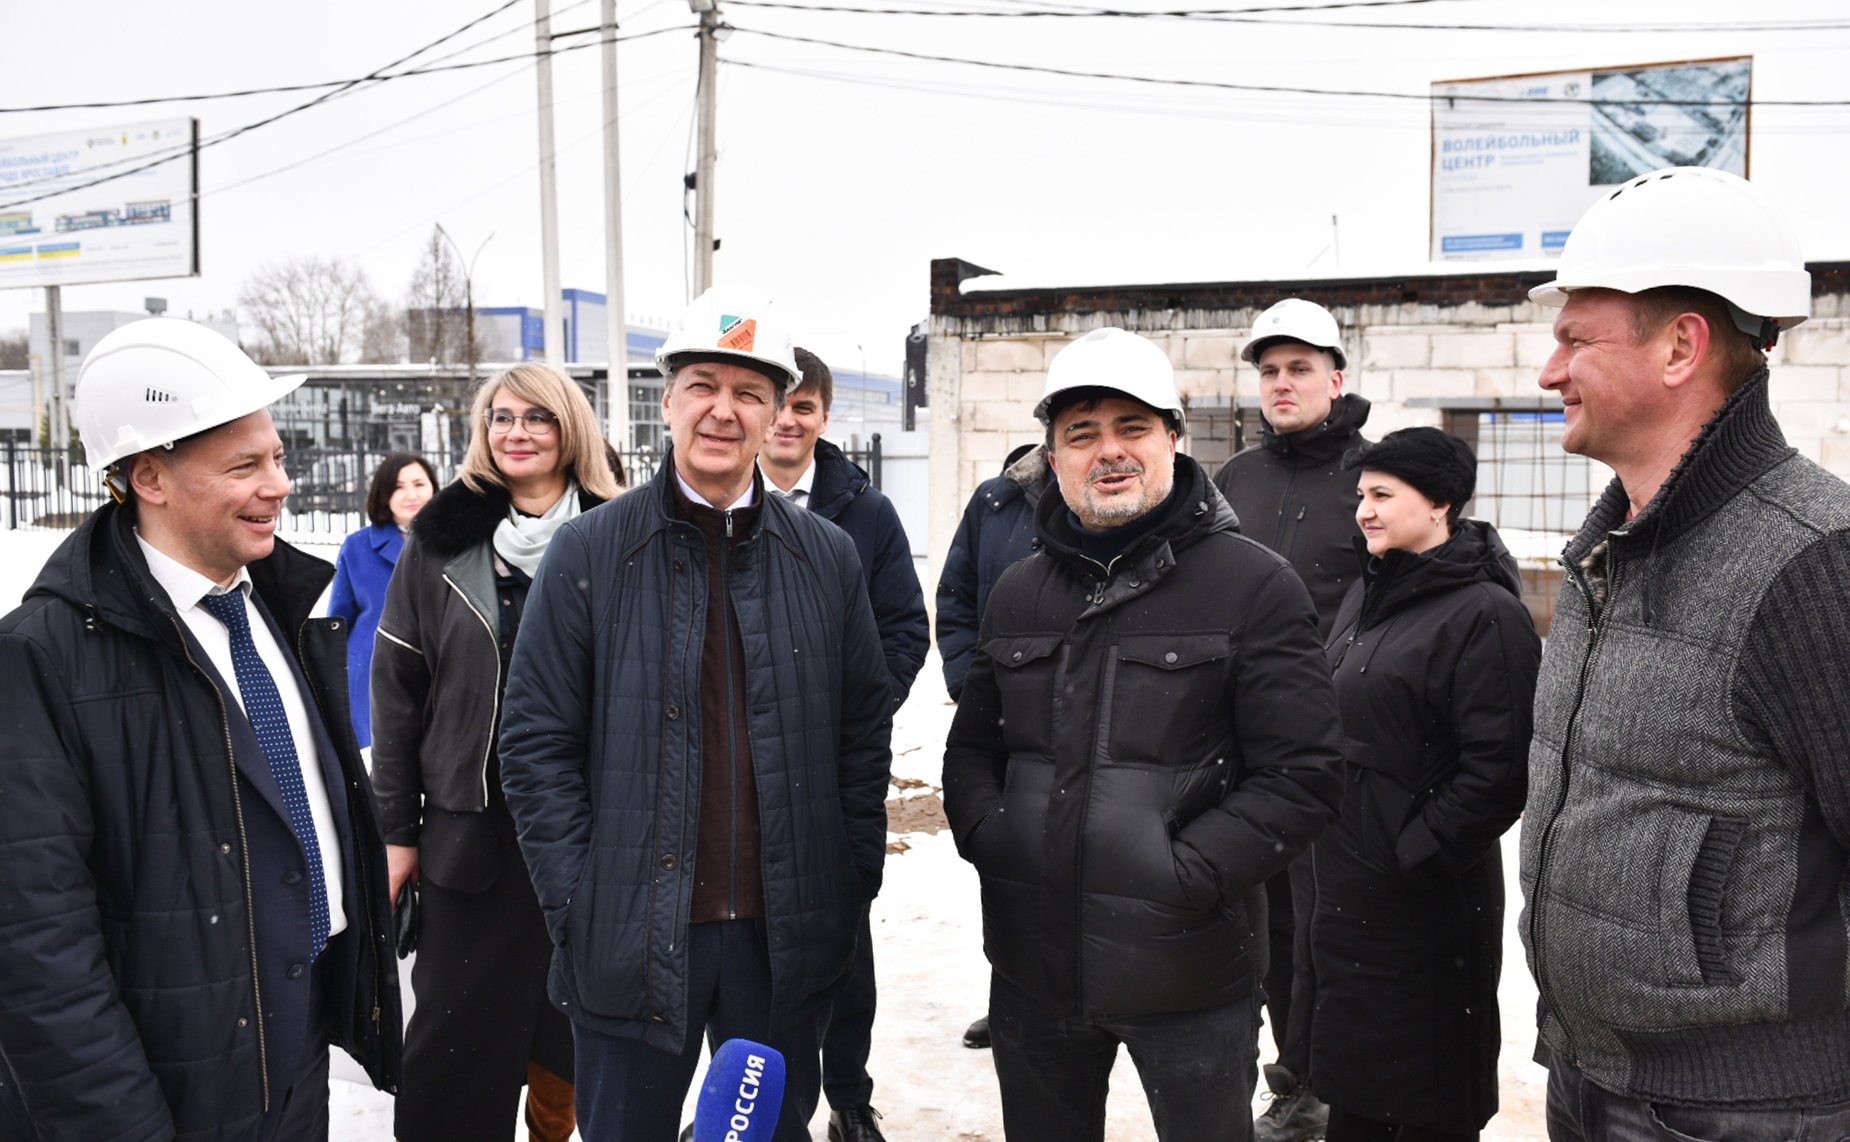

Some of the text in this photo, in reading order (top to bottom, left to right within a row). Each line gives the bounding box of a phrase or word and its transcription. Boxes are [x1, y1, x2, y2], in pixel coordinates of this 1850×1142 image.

[1442, 128, 1580, 153] ВОЛЕЙБОЛЬНЫЙ
[1442, 155, 1495, 171] ЦЕНТР
[724, 1054, 766, 1142] РОССИЯ
